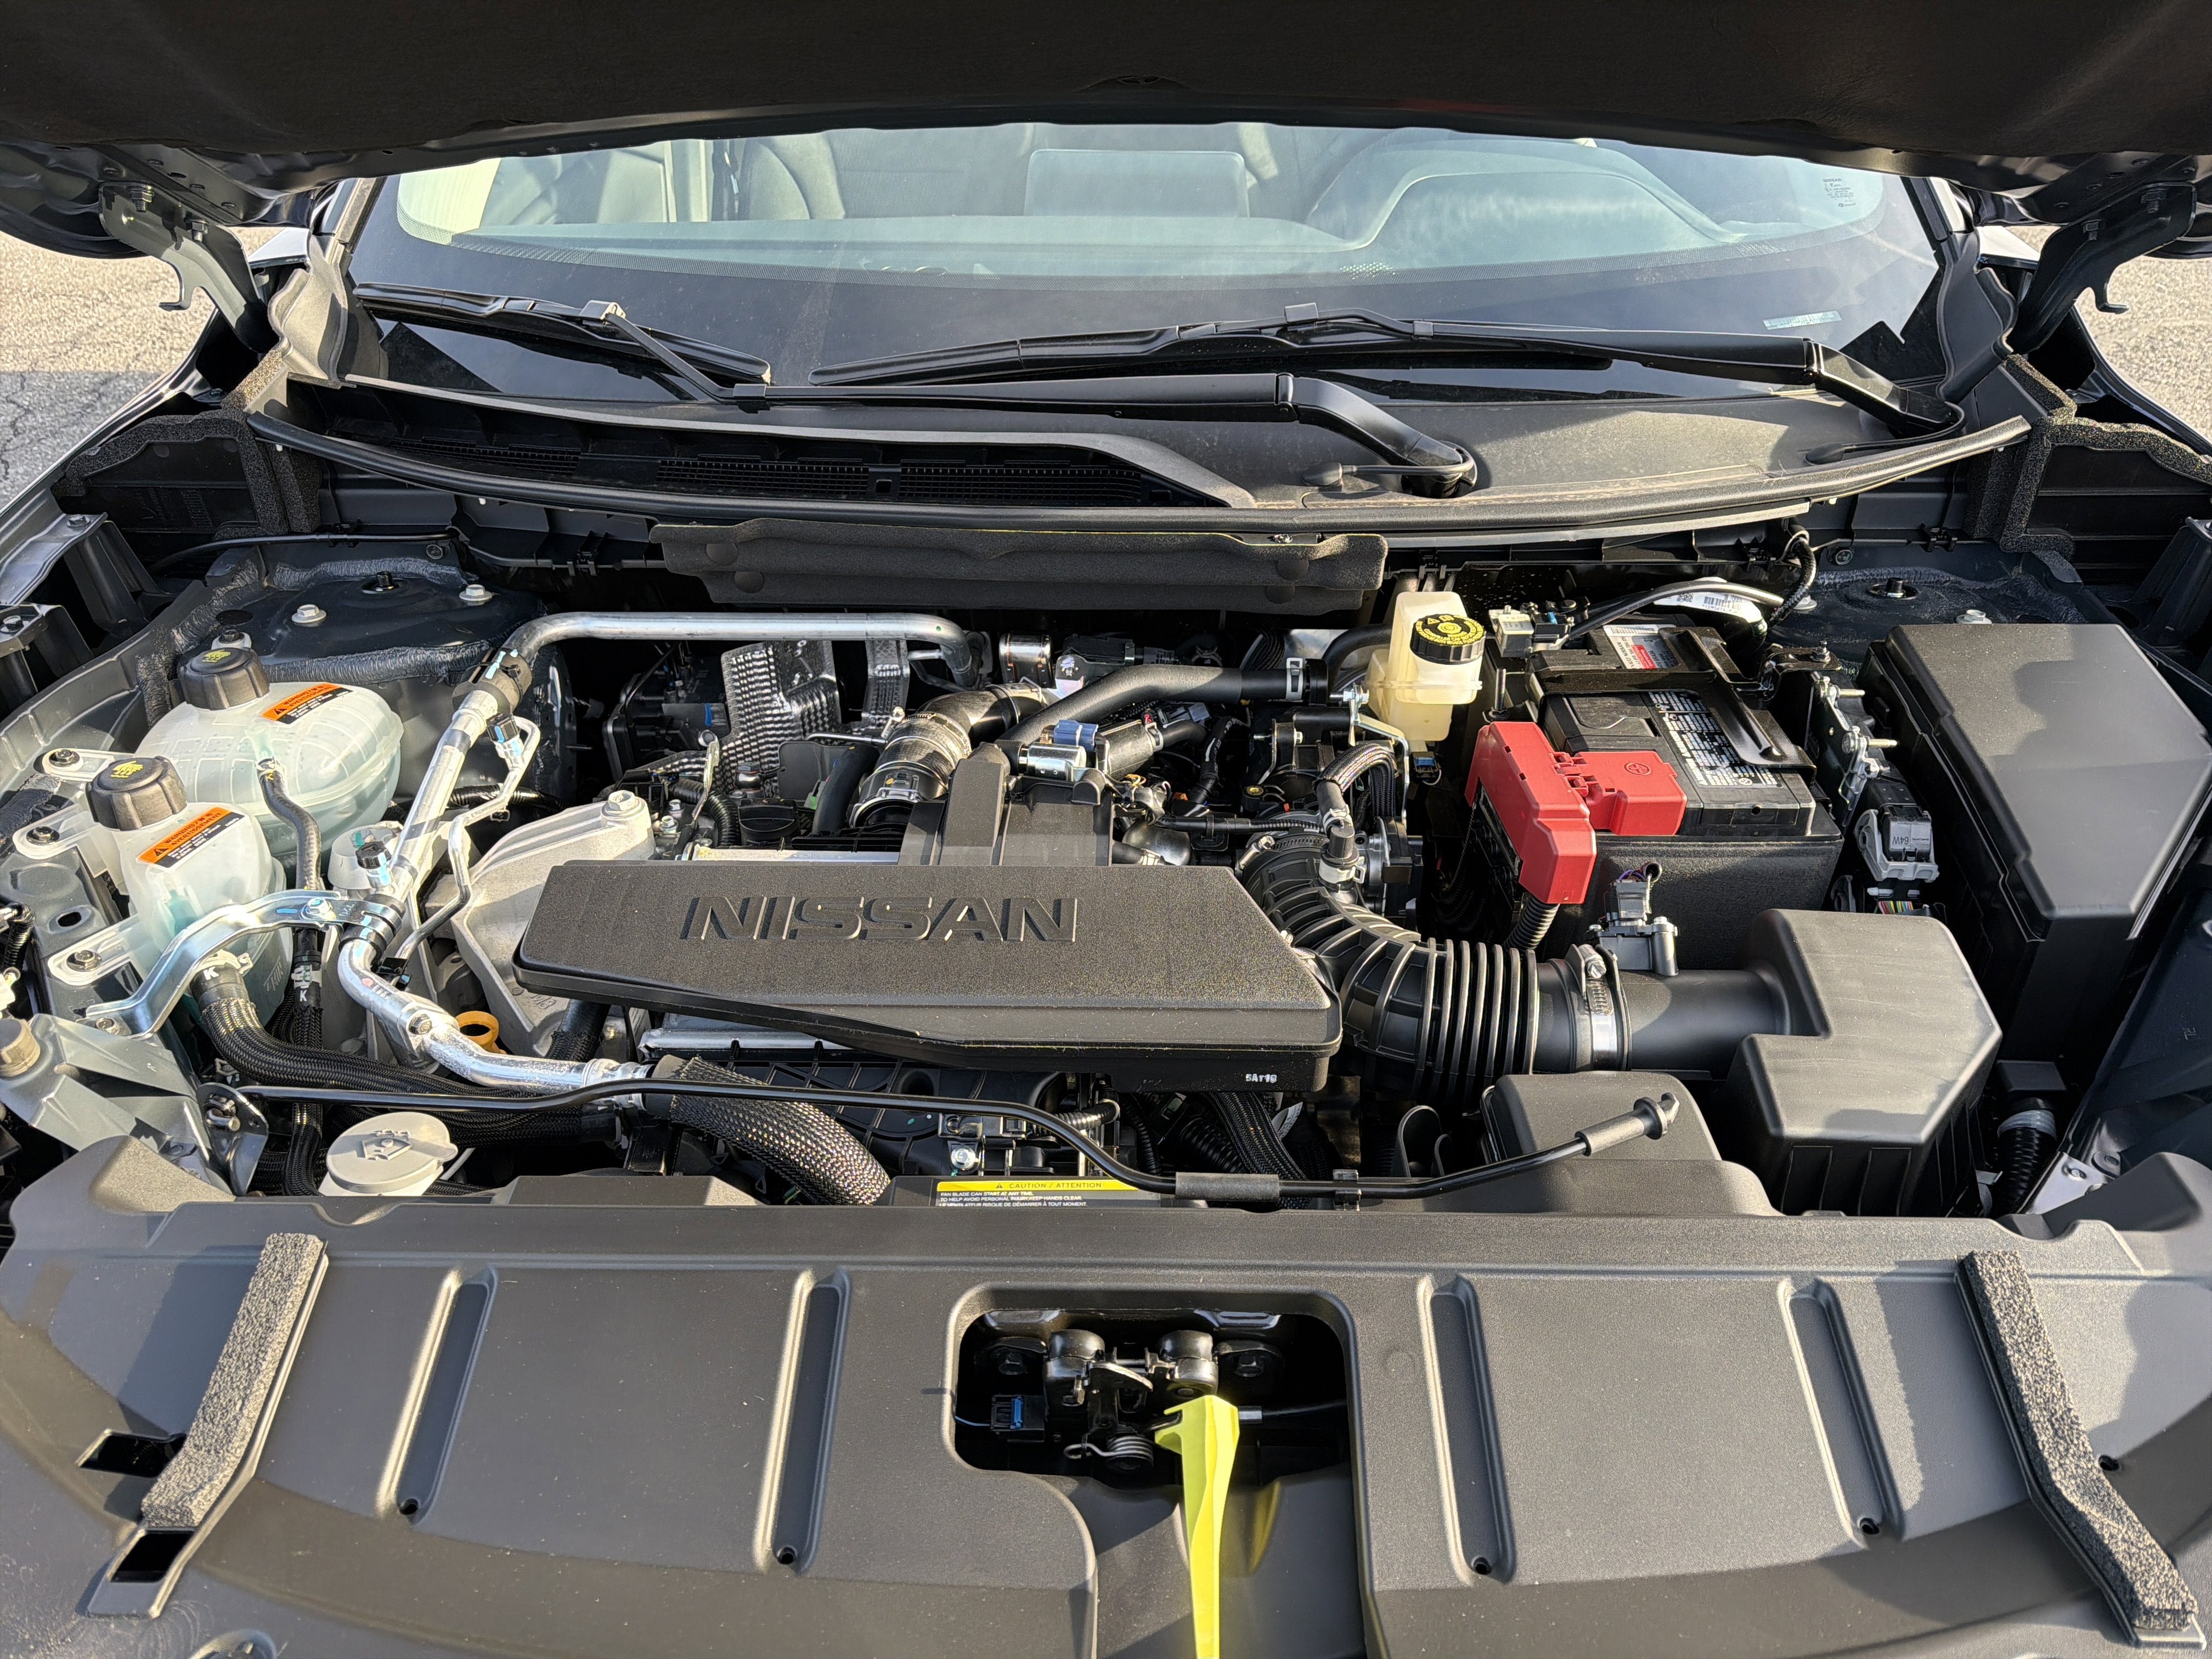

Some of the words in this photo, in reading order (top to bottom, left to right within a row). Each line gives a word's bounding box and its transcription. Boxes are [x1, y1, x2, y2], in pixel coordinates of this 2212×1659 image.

[1892, 836, 1909, 845] 64W
[684, 895, 1079, 942] NISSAN
[300, 990, 307, 1002] K
